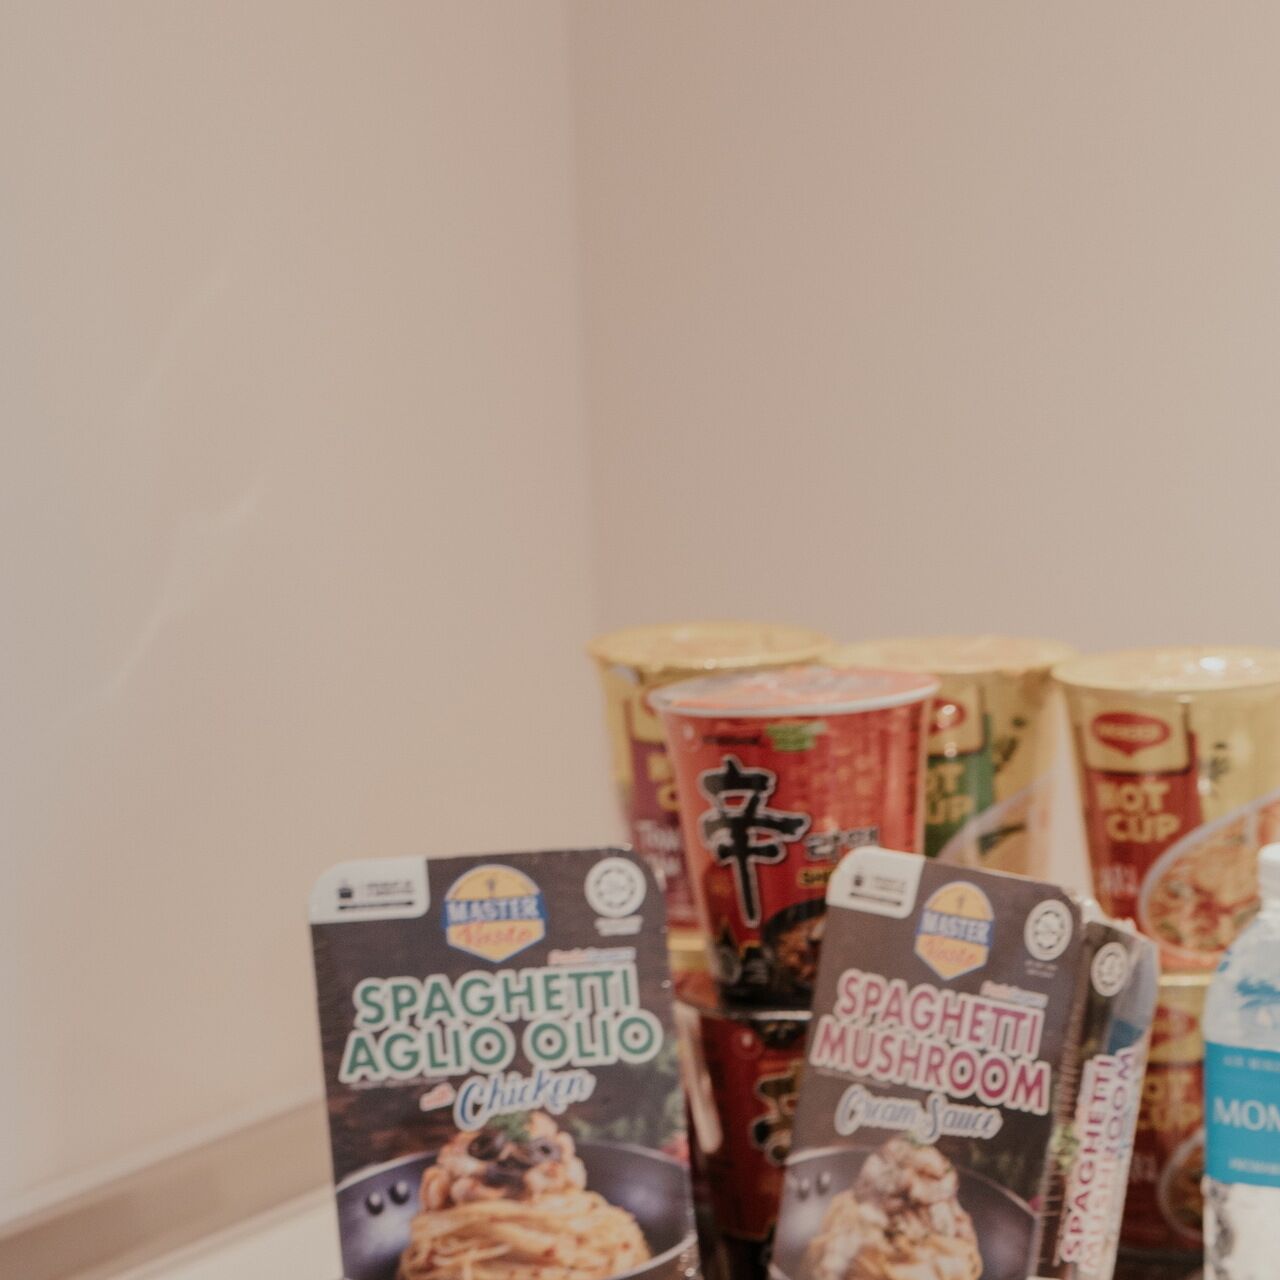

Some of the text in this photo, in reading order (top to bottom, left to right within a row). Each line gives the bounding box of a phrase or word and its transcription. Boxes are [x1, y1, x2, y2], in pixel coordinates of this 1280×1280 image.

[699, 756, 810, 926] 辛
[447, 896, 540, 923] MASTER
[920, 910, 992, 946] MASTER
[358, 968, 633, 1024] SPAGHETTI
[839, 975, 1041, 1053] SPAGHETTI
[345, 1016, 655, 1076] AGLIO OLIO
[814, 1021, 1047, 1110] MUSHROOM
[457, 1068, 588, 1127] Chicken
[837, 1089, 1001, 1141] Cream Sauce
[1065, 1060, 1113, 1257] SPAGHETTI
